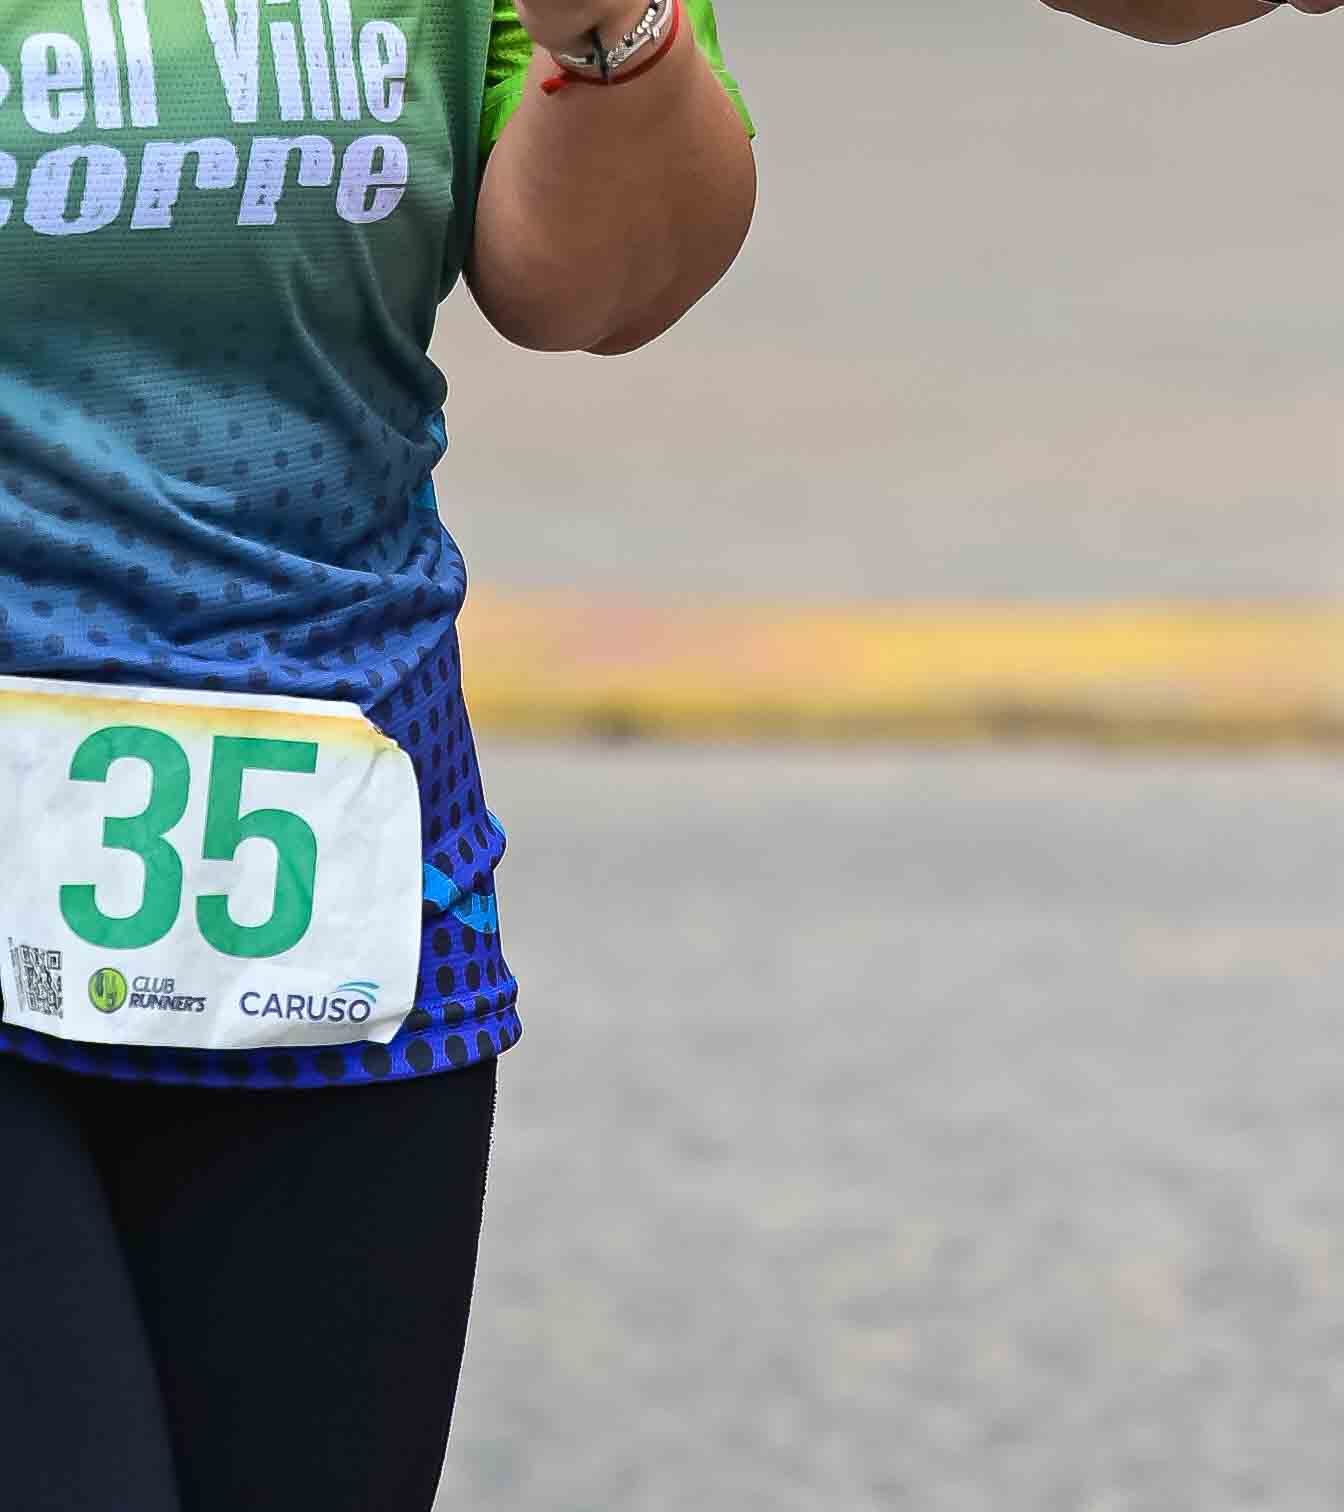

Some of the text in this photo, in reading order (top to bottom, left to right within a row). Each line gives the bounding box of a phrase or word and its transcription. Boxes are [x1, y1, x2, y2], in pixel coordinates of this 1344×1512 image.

[0, 134, 409, 236] orre
[59, 725, 320, 959] 35
[132, 976, 175, 994] CLUB
[128, 993, 207, 1013] RUNNER'S
[239, 990, 372, 1024] CARUSO
